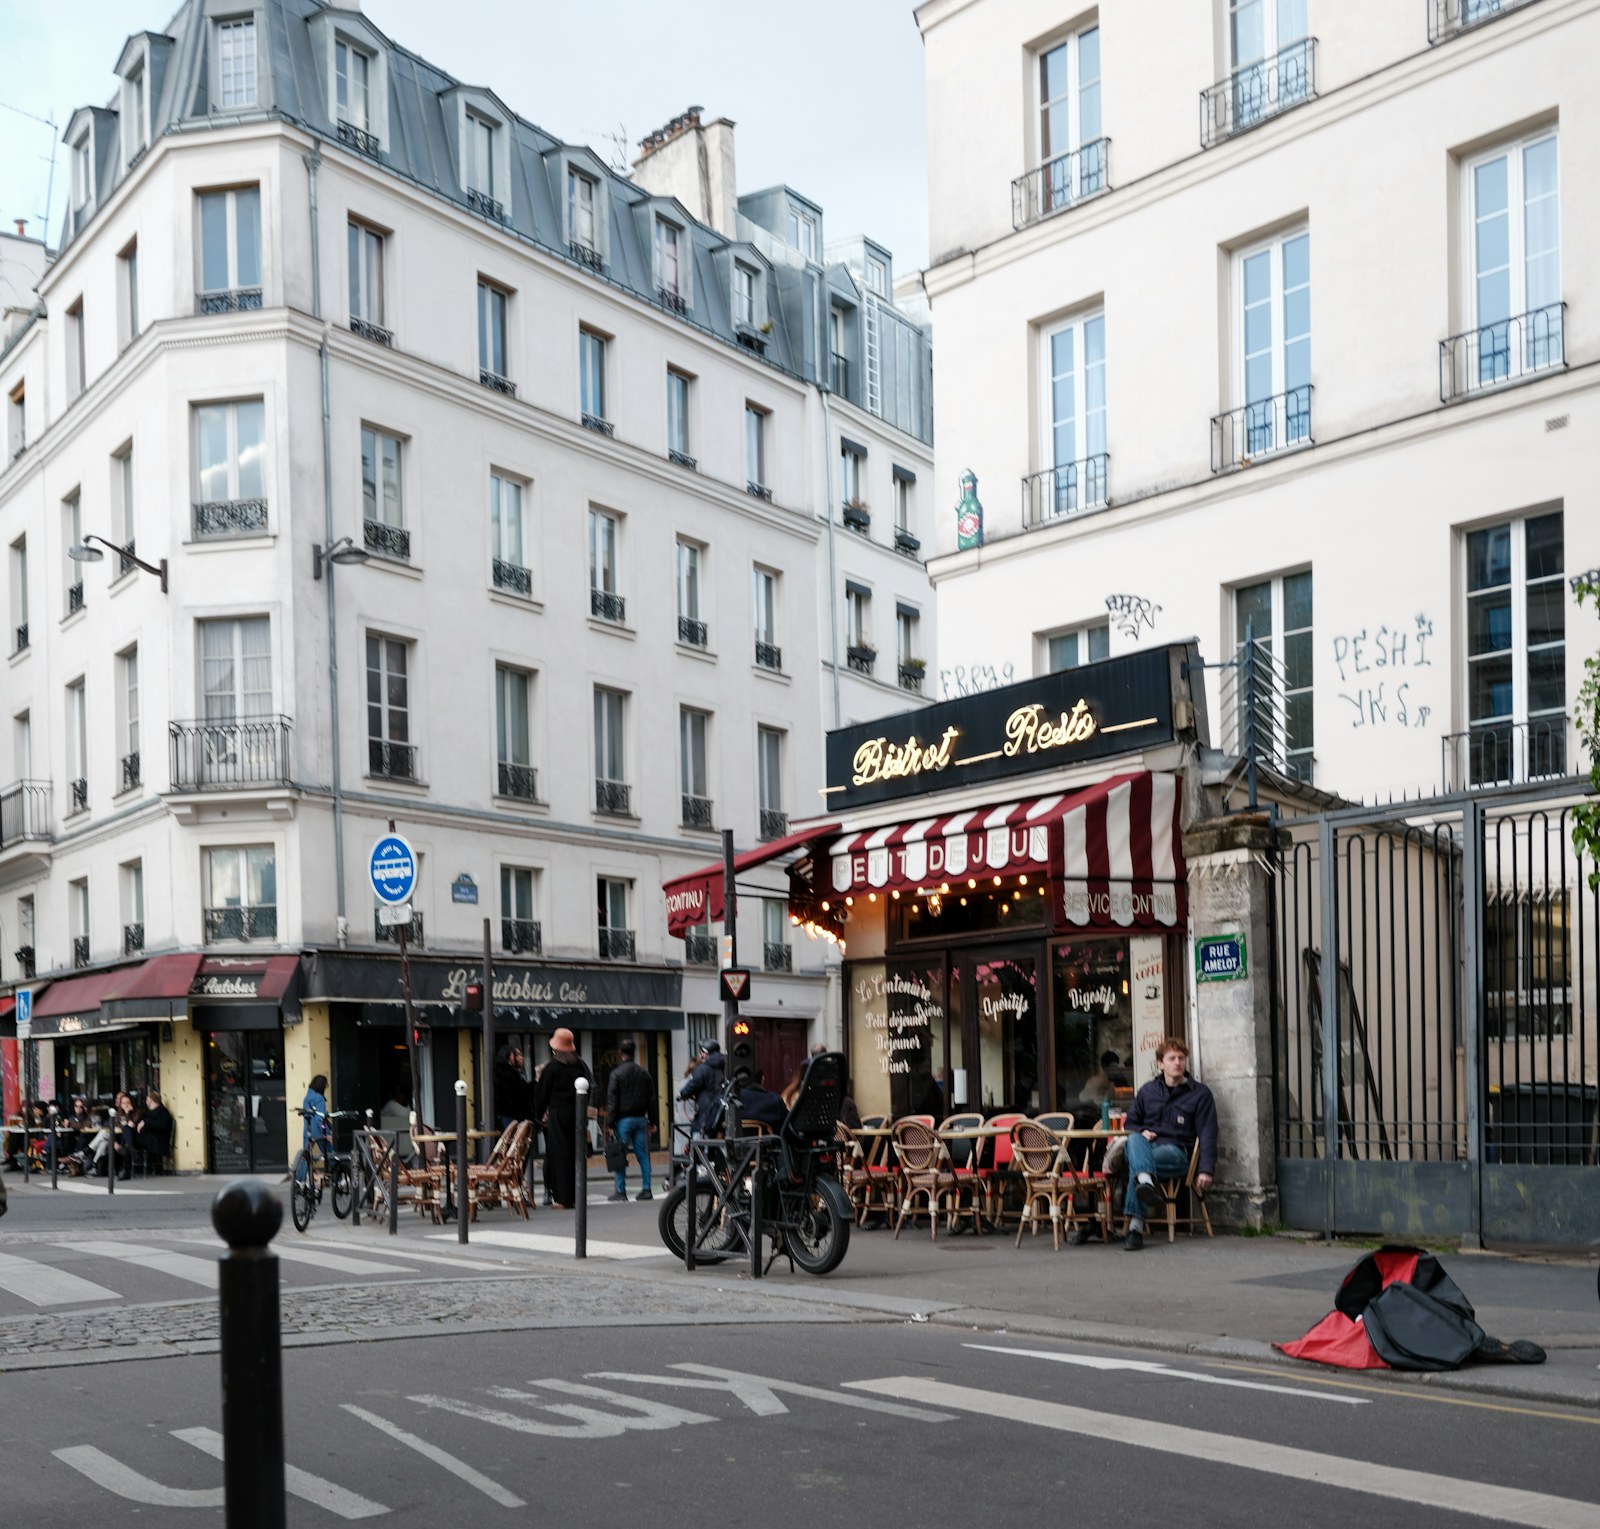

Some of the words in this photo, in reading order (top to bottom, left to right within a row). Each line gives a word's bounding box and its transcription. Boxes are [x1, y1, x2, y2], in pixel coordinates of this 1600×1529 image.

[852, 726, 960, 786] Bistrot
[1004, 698, 1097, 757] Resto
[834, 848, 908, 886] PETIT
[1063, 891, 1119, 914] SERVICE
[1121, 893, 1177, 915] CONTINU
[1204, 957, 1238, 972] AMELOT
[1209, 944, 1230, 958] RUE
[442, 968, 554, 1001] L'utobus
[1069, 984, 1116, 1014] Digestifs
[865, 1011, 887, 1029] Petit
